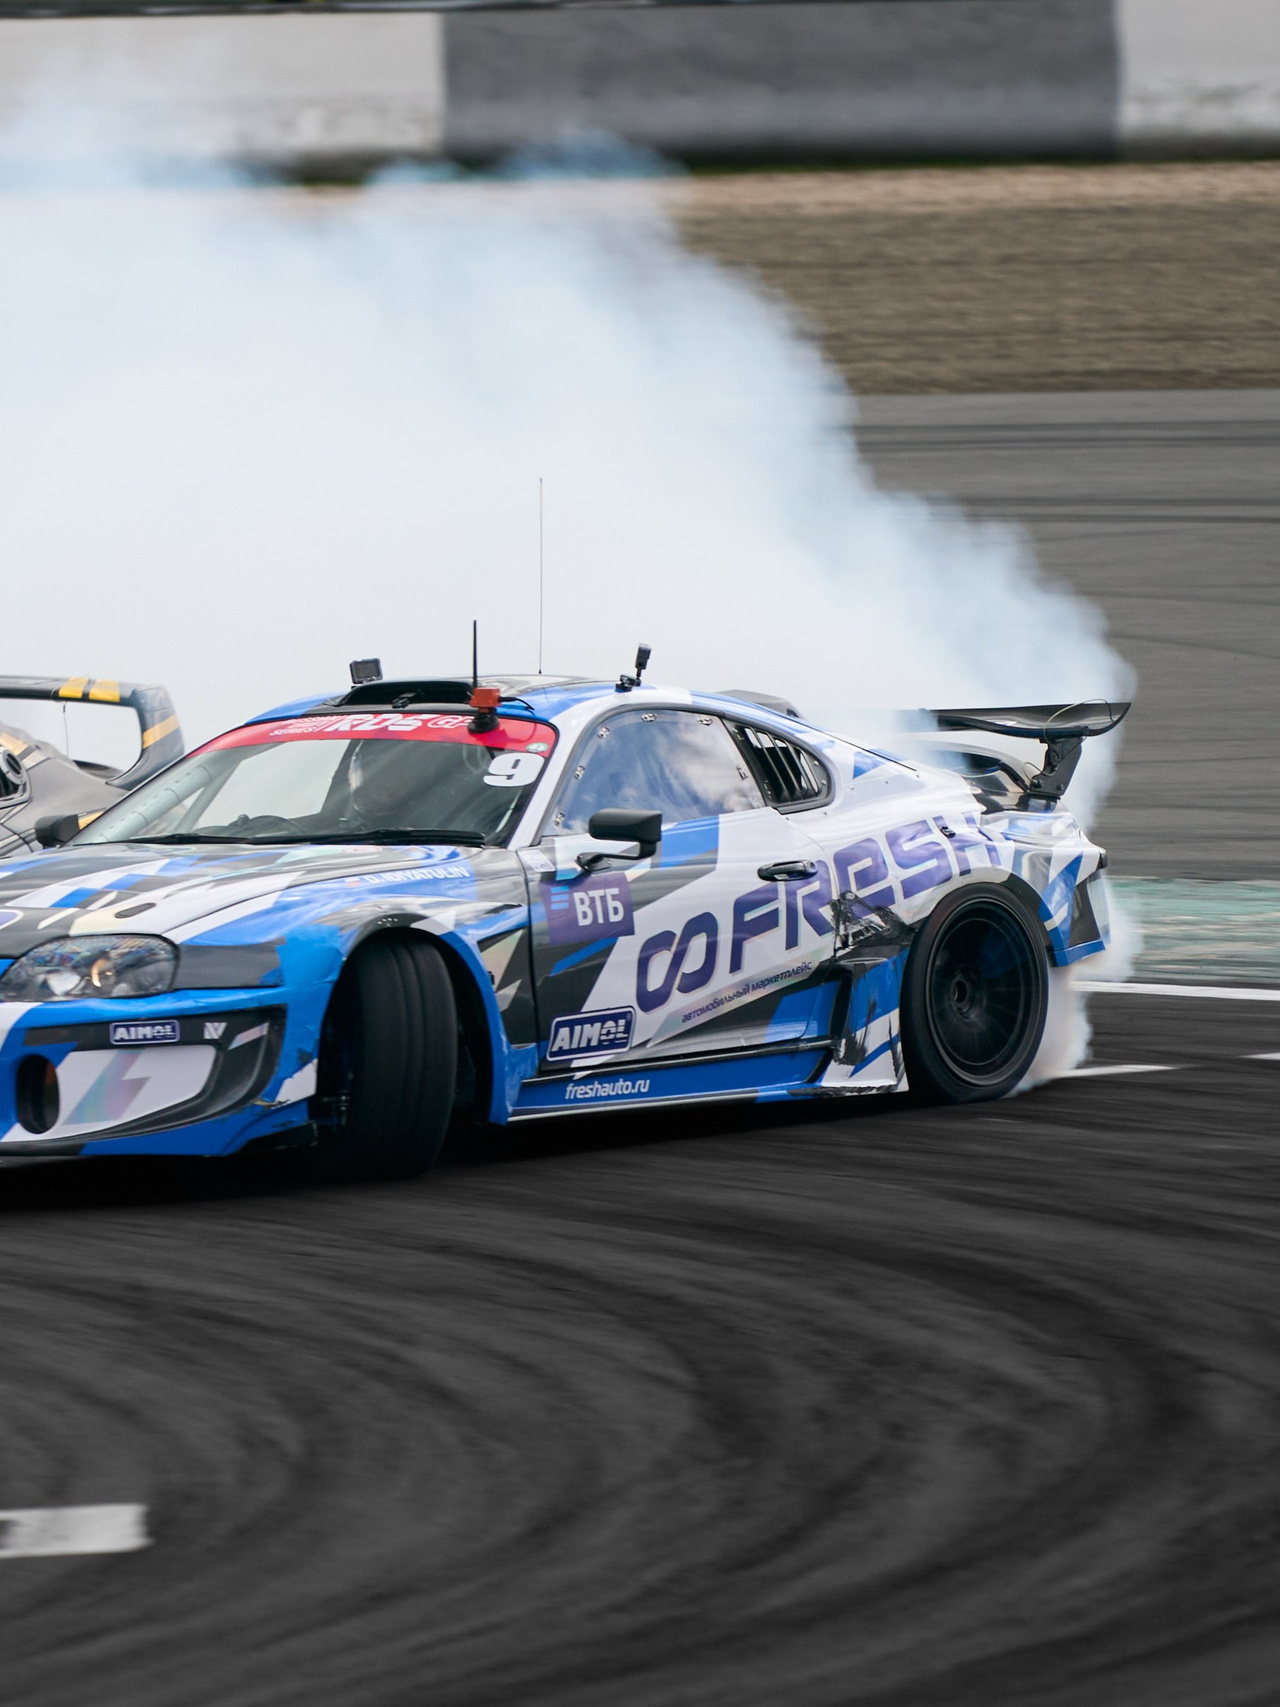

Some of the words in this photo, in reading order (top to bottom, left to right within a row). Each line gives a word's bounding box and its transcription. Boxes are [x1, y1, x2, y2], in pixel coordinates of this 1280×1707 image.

[323, 713, 441, 732] RDS
[483, 752, 546, 788] 9
[572, 887, 625, 927] ВТБ
[681, 982, 751, 1024] автомобильный
[751, 960, 813, 993] маркетплейс
[113, 1025, 177, 1041] AIMOL
[550, 1018, 629, 1053] AIMOL
[564, 1078, 650, 1100] freshauto.ru
